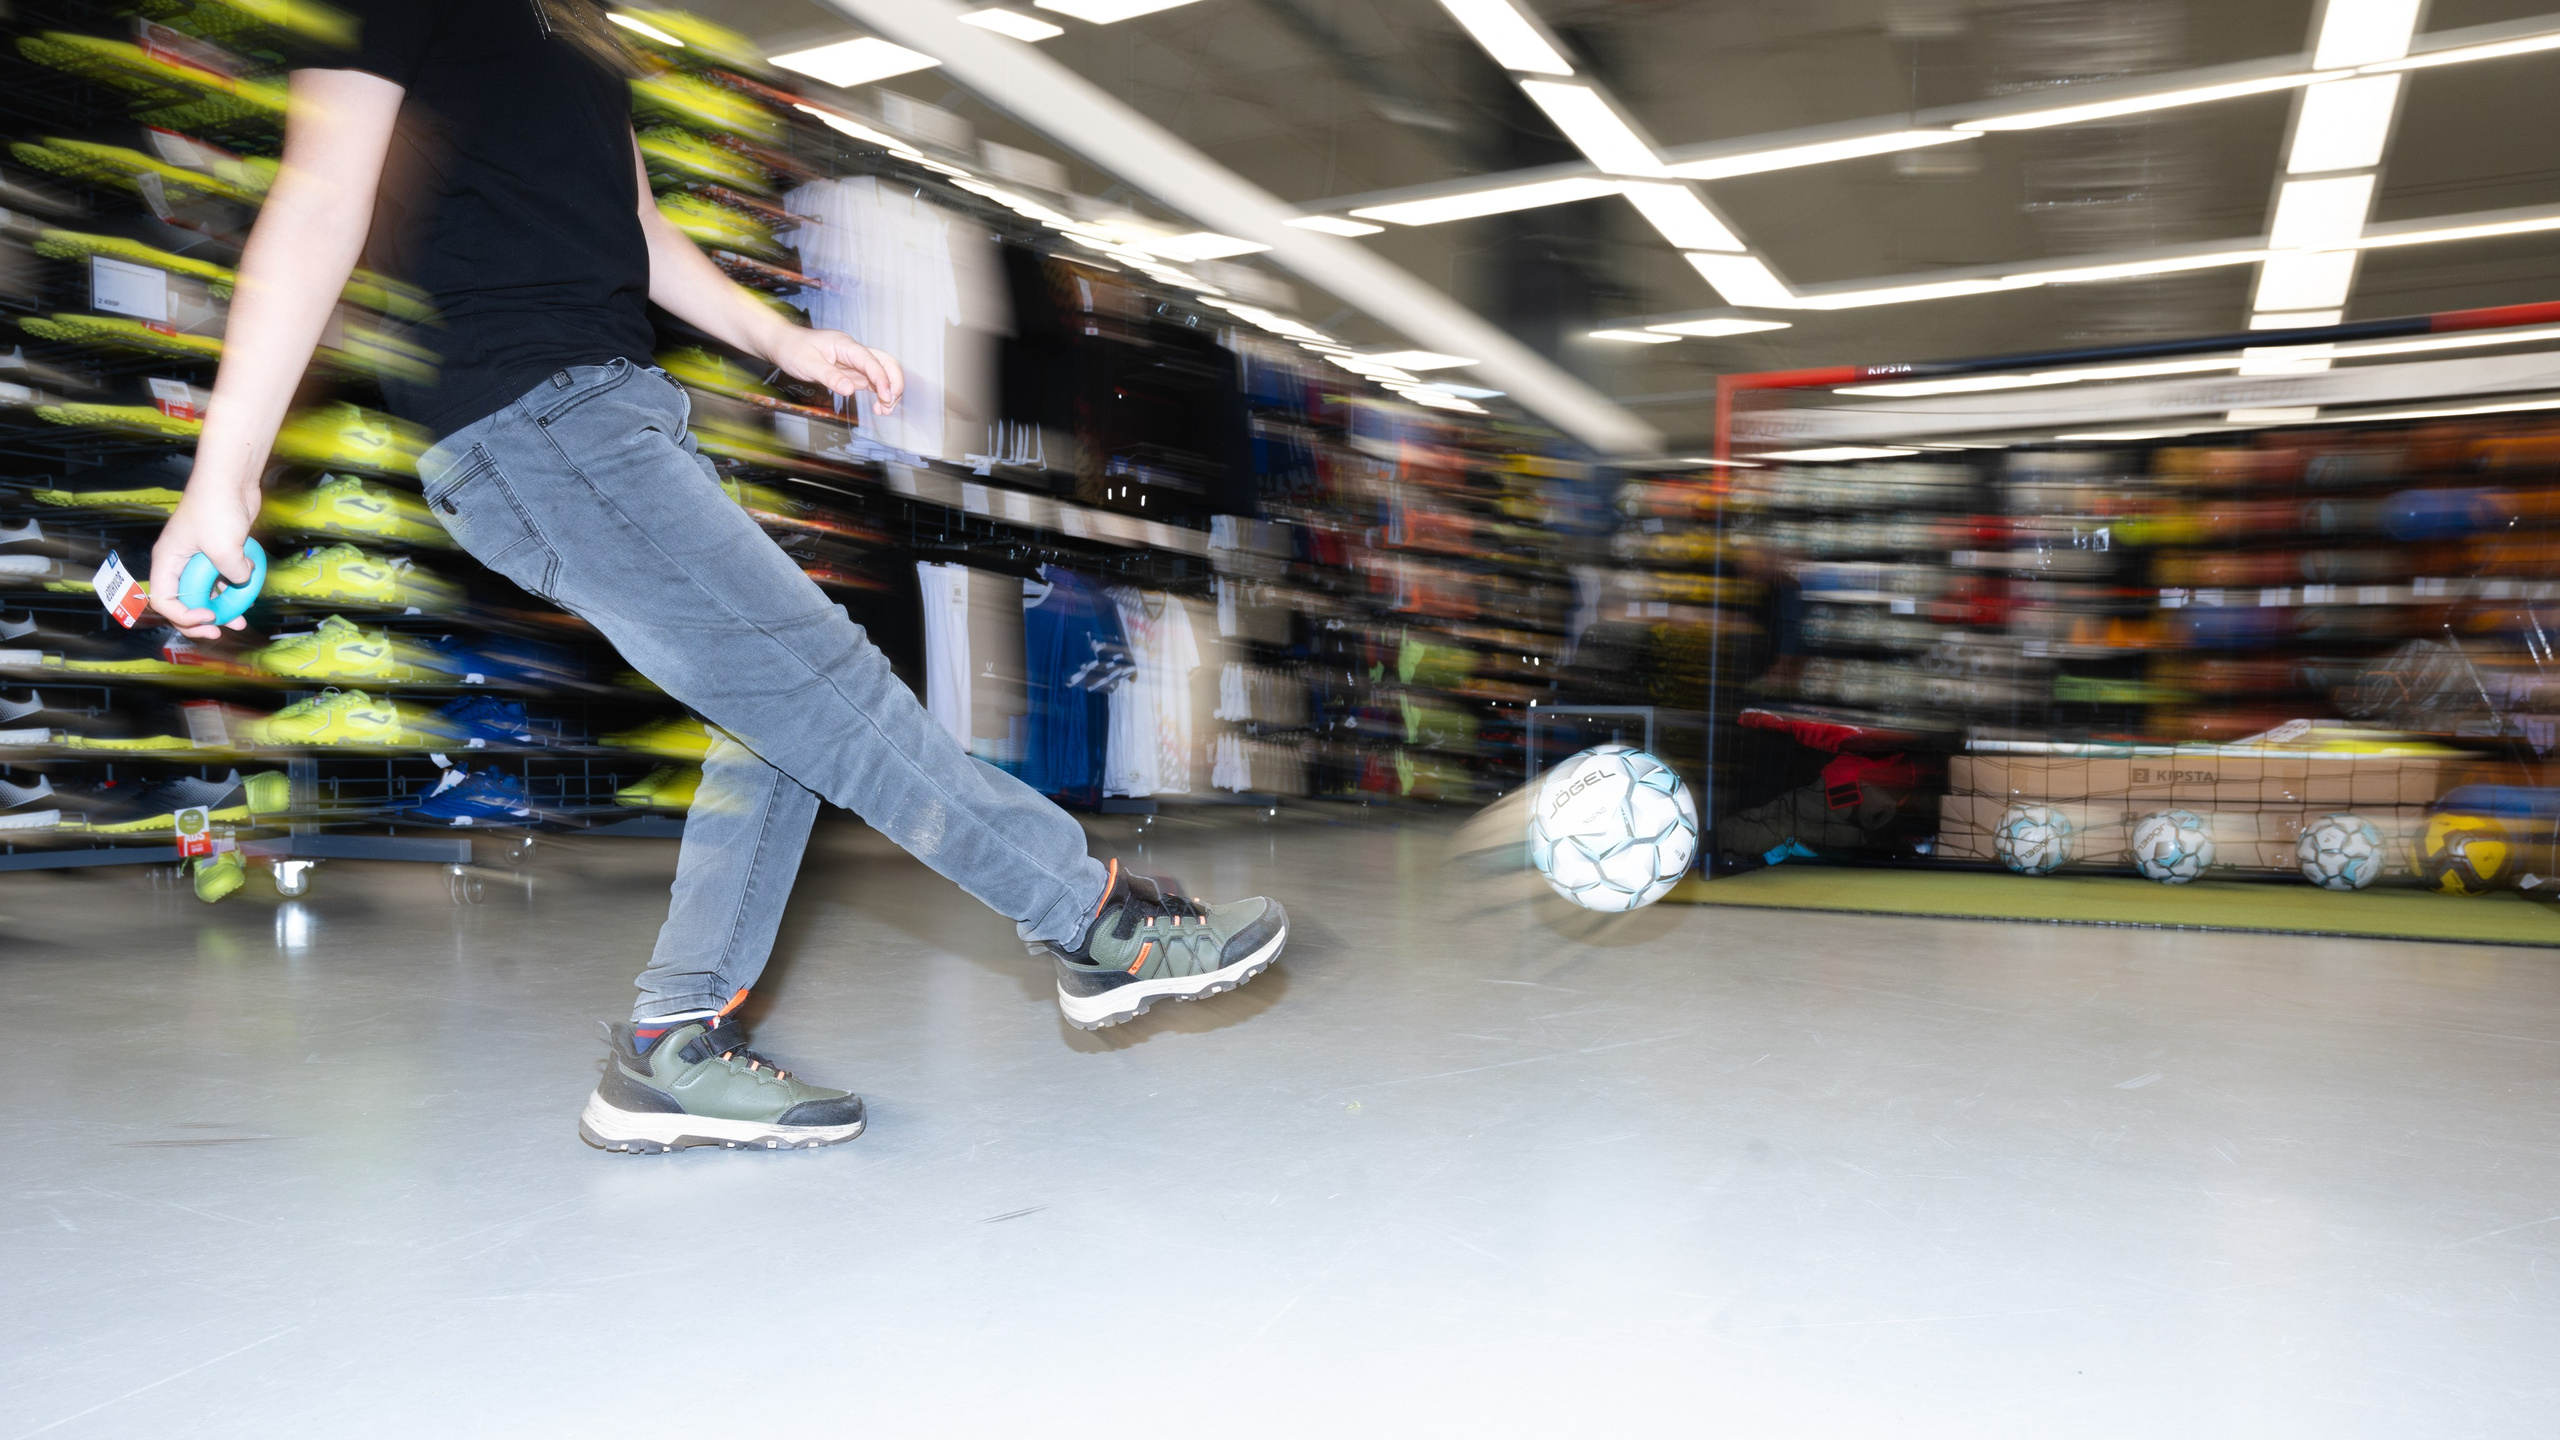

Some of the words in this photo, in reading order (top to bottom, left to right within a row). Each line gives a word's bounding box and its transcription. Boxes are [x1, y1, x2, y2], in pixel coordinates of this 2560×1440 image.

[1867, 363, 1912, 376] KIPSTA
[2156, 769, 2215, 782] KIPSTA
[1549, 769, 1617, 820] JÖGEL
[2137, 822, 2167, 851] JÖGEL
